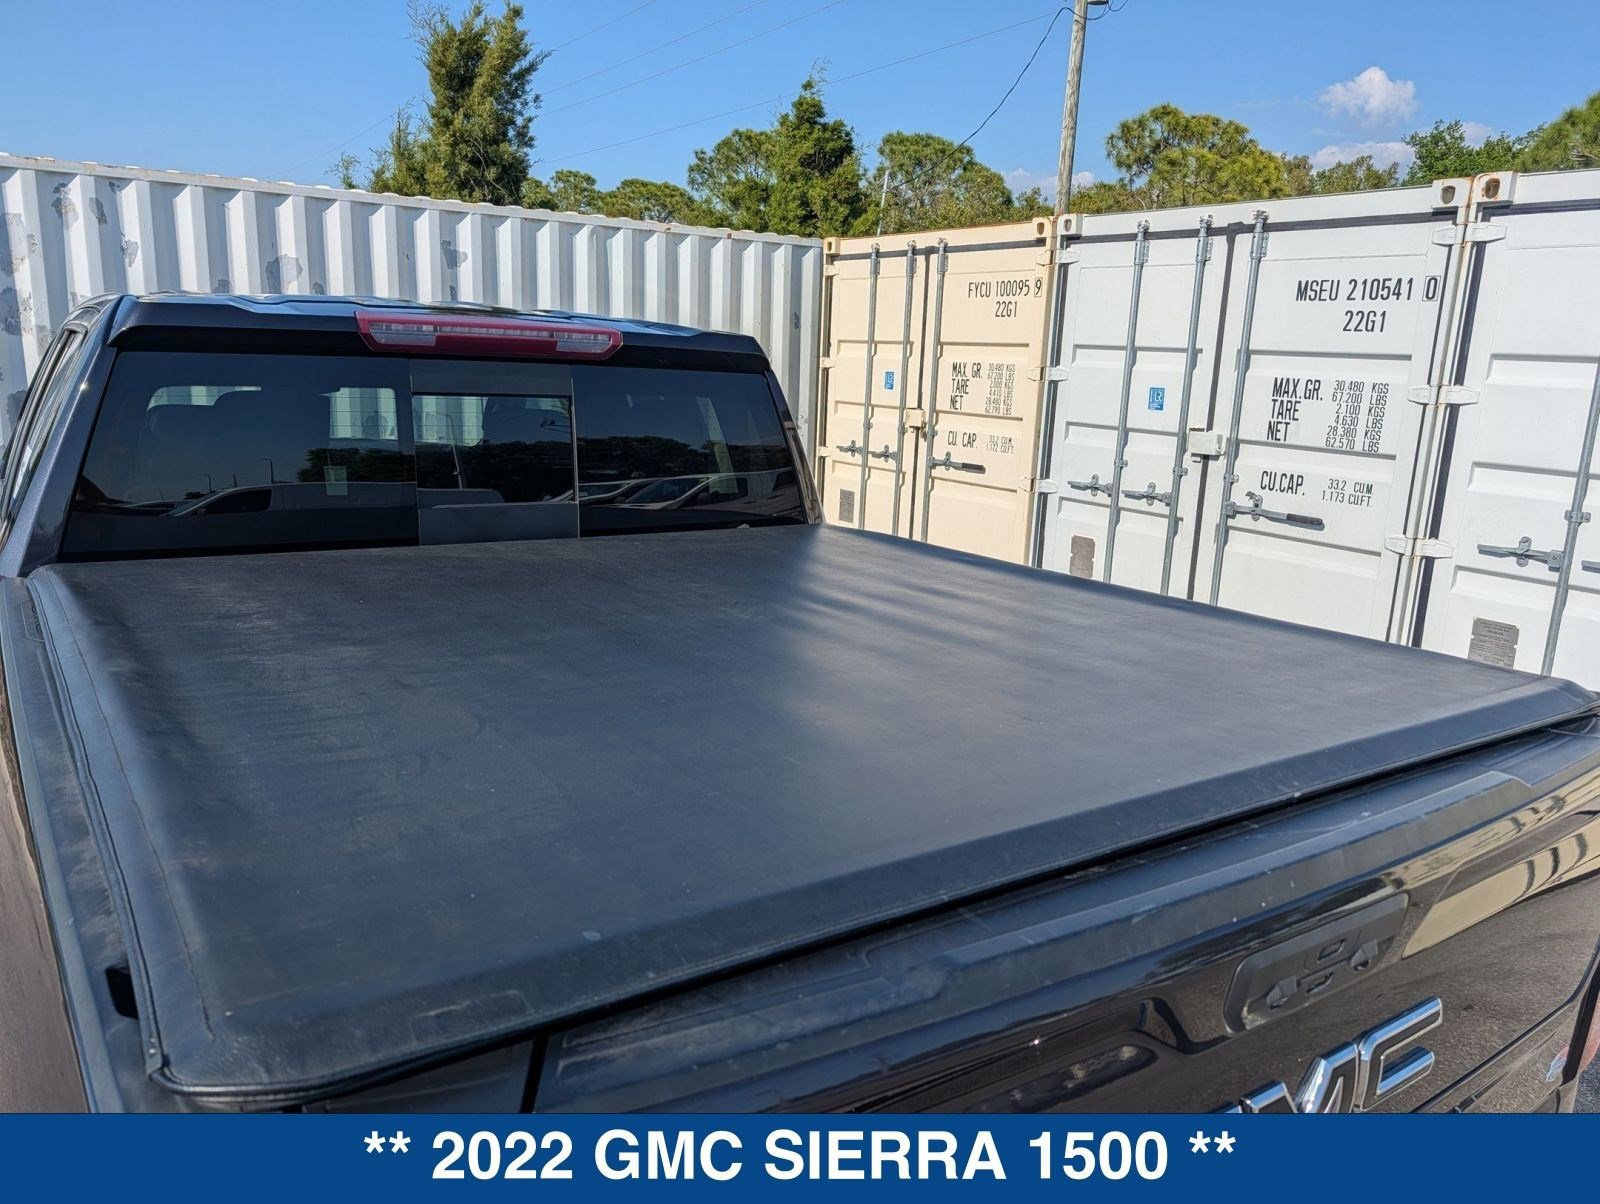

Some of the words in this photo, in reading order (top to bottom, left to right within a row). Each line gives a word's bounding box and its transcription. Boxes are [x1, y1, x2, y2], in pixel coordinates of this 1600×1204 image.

[968, 281, 991, 298] FYCU
[995, 280, 1030, 297] 100095
[1035, 278, 1042, 296] 9
[1296, 279, 1341, 301] MSEU
[1346, 277, 1413, 301] 210541
[1424, 276, 1439, 300] 0
[995, 301, 1017, 318] 22G1
[1343, 310, 1386, 333] 22G1
[971, 364, 983, 379] GR.
[1006, 364, 1016, 372] KGS
[1005, 373, 1015, 381] LBS
[952, 379, 969, 395] TARE
[1004, 381, 1014, 389] KGS
[1003, 390, 1013, 398] LBS
[1334, 380, 1365, 393] 30.480
[1371, 382, 1389, 395] KGS
[950, 395, 964, 410] NET
[1003, 398, 1013, 407] KGS
[1331, 392, 1363, 404] 67.200
[1369, 394, 1388, 406] LBS
[1003, 407, 1012, 415] LBS
[1271, 399, 1301, 422] TARE
[1335, 403, 1361, 416] 2.100
[1367, 406, 1386, 418] KGS
[1334, 415, 1359, 427] 4.630
[1366, 417, 1384, 429] LBS
[1267, 420, 1291, 442] NET
[1326, 425, 1357, 438] 28.380
[1363, 429, 1382, 441] KGS
[962, 432, 978, 449] CAP.
[1325, 436, 1355, 450] 62.570
[1362, 440, 1380, 453] LBS
[1328, 478, 1347, 491] 33.2
[1322, 490, 1345, 503] 1.173
[1206, 997, 1442, 1113] MC
